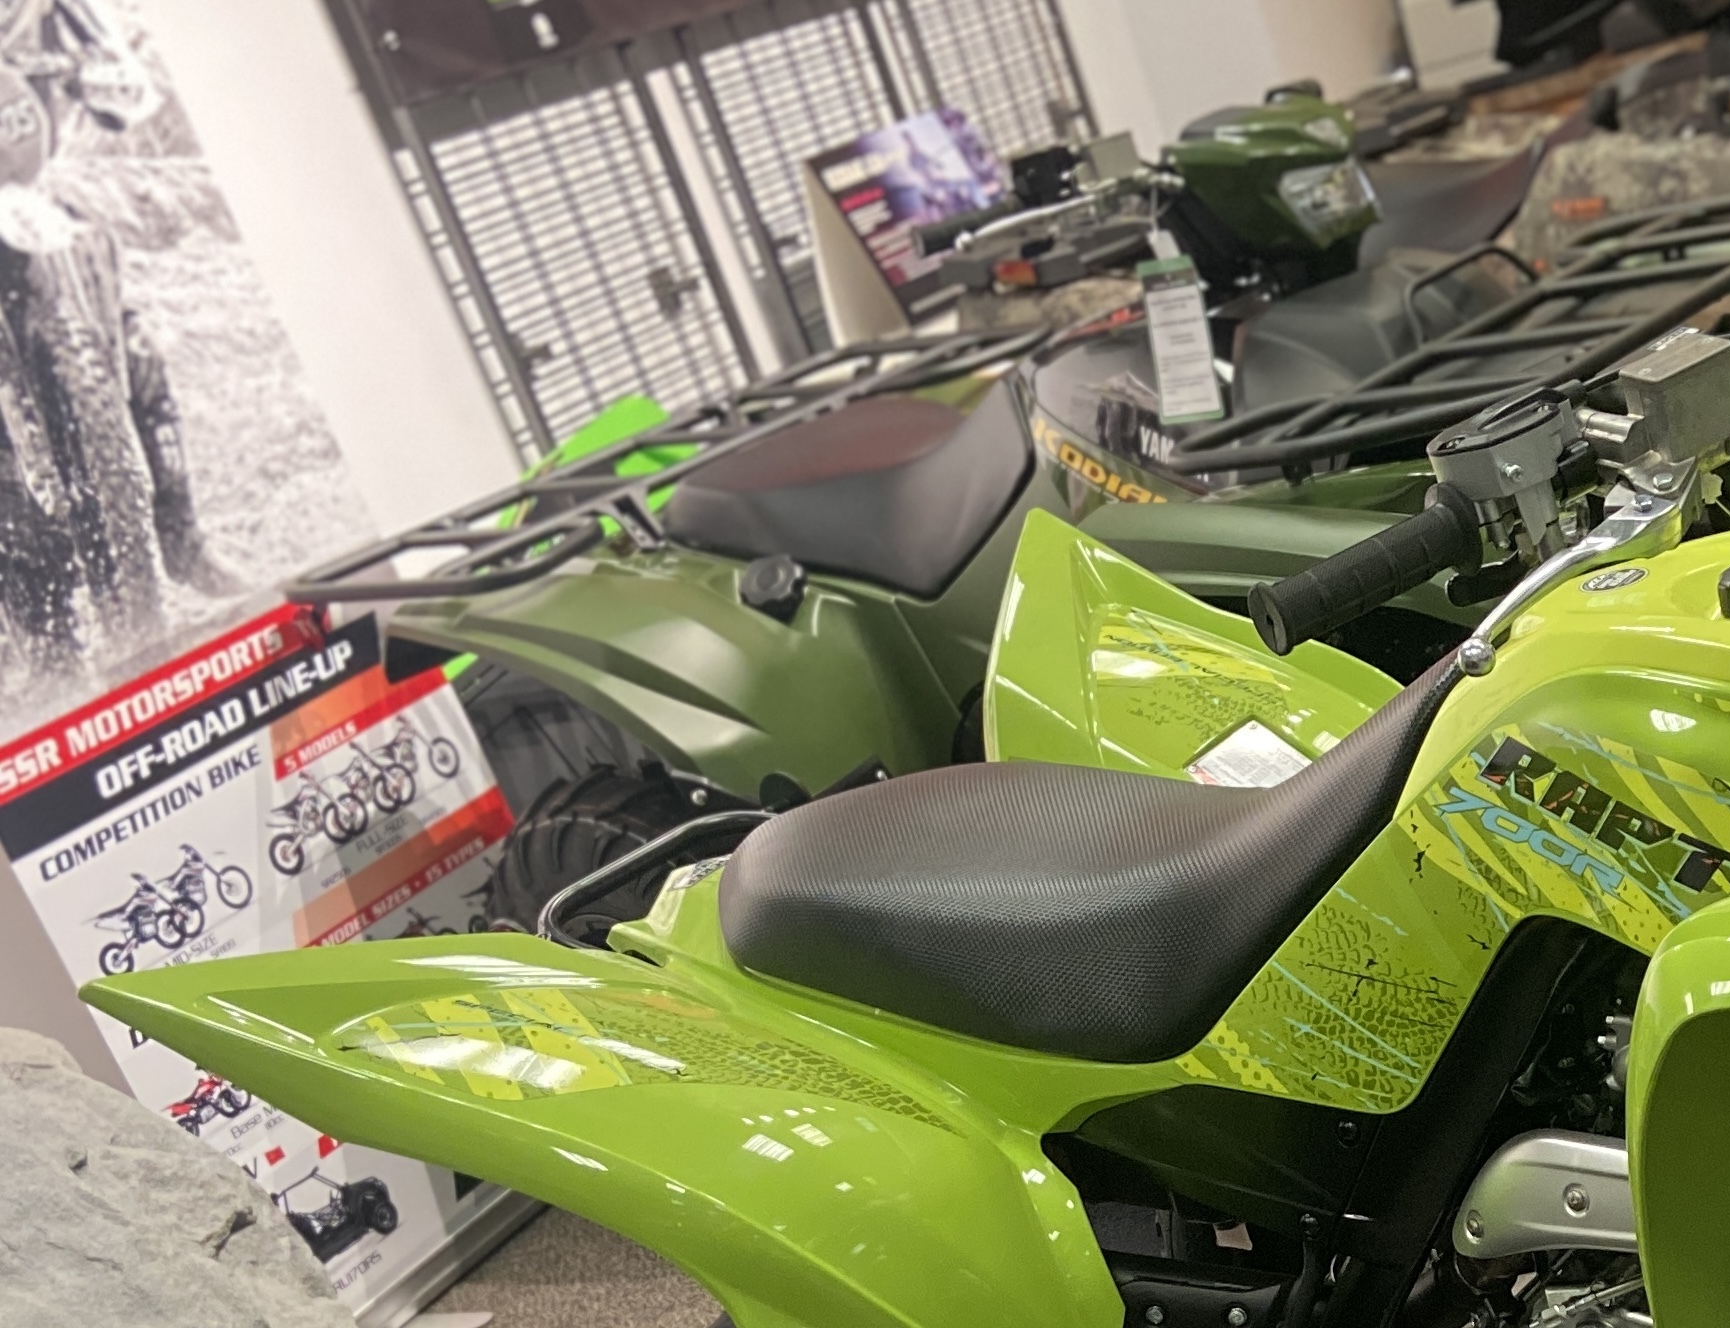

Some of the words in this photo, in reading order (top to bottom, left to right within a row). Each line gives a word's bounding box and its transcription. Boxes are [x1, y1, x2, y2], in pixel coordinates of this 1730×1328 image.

[65, 623, 283, 757] MOTORSPORTS
[94, 699, 246, 799] OFF-ROAD
[247, 640, 354, 718] LINE-UP
[299, 720, 358, 767] MODELS
[39, 774, 204, 882] COMPETITION
[207, 742, 263, 791] BIKE
[1432, 786, 1632, 902] 700R
[321, 908, 371, 948] MODEL
[371, 883, 412, 918] SIZES
[445, 837, 486, 868] TYPES
[230, 1111, 263, 1140] Base
